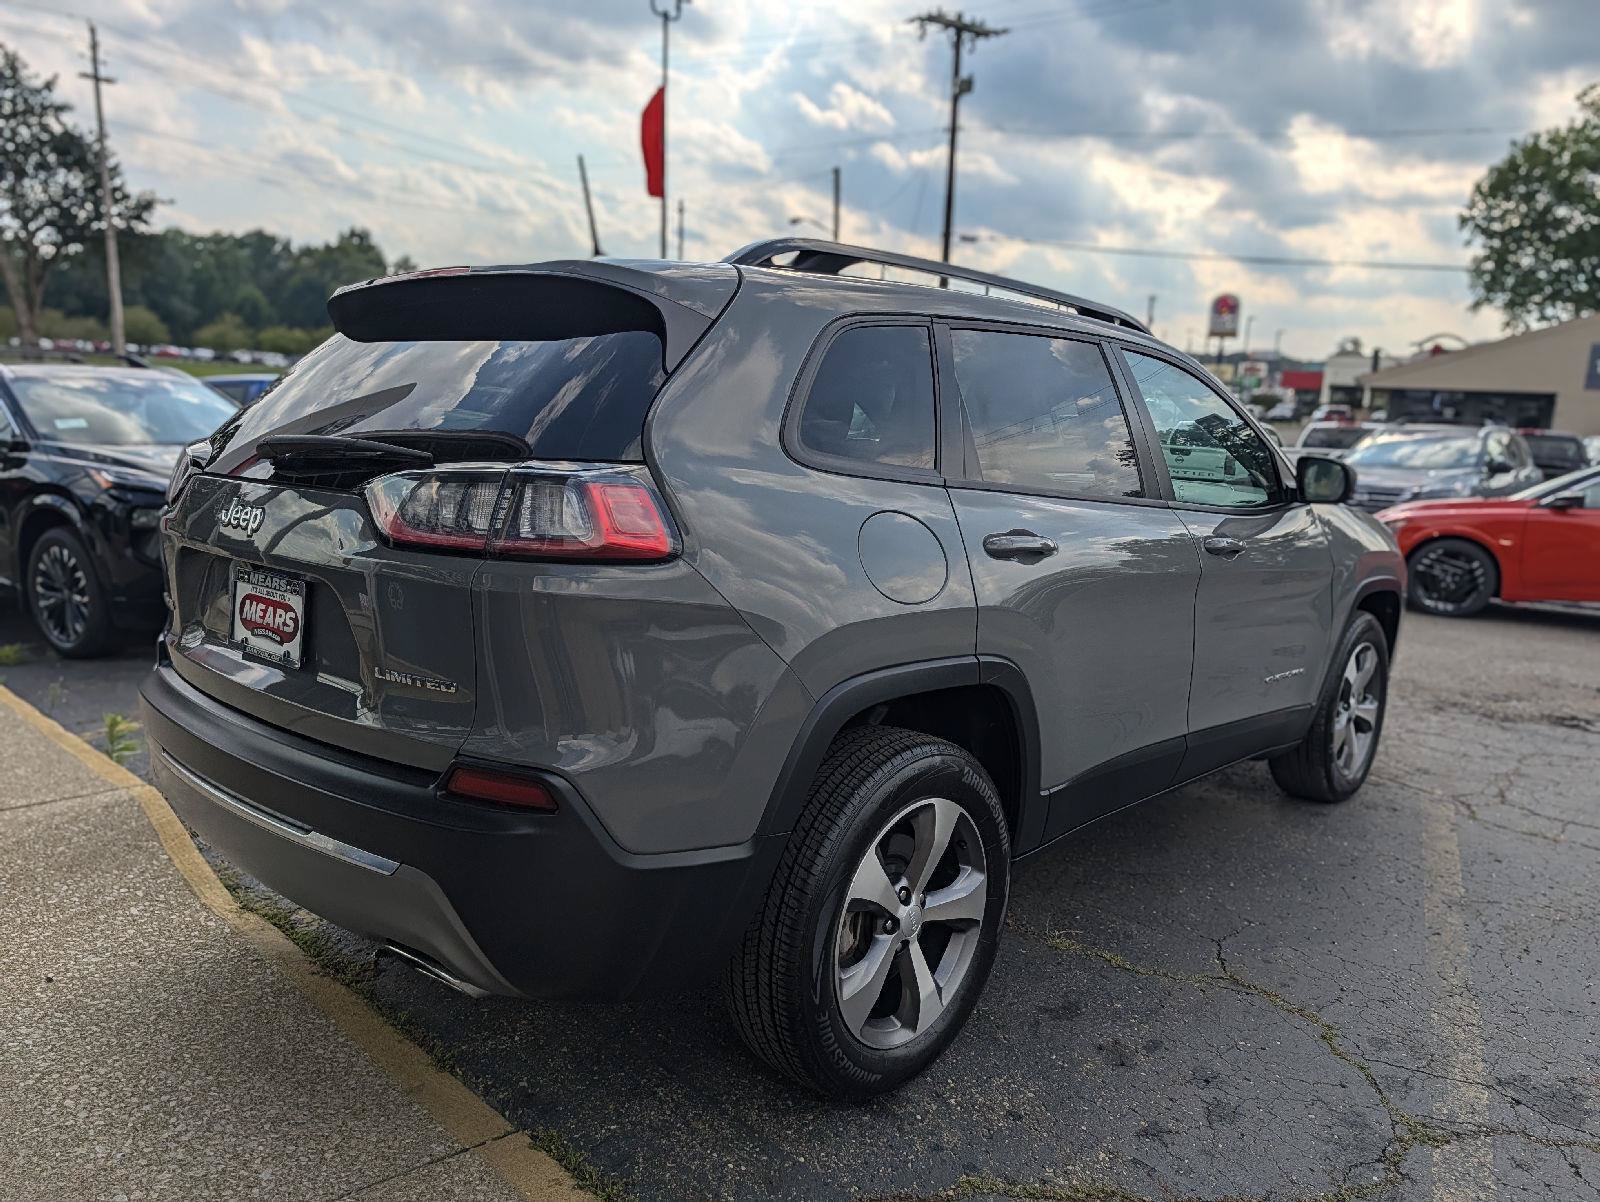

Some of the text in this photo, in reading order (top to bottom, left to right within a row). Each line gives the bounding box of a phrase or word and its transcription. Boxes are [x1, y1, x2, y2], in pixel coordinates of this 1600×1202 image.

[221, 497, 264, 536] Jeep
[249, 573, 287, 591] MEARS
[242, 600, 296, 633] MEARS
[374, 666, 457, 693] LIMITED
[962, 766, 1008, 855] BRIDGESTONE
[815, 1010, 882, 1083] BRIDGESTONE
